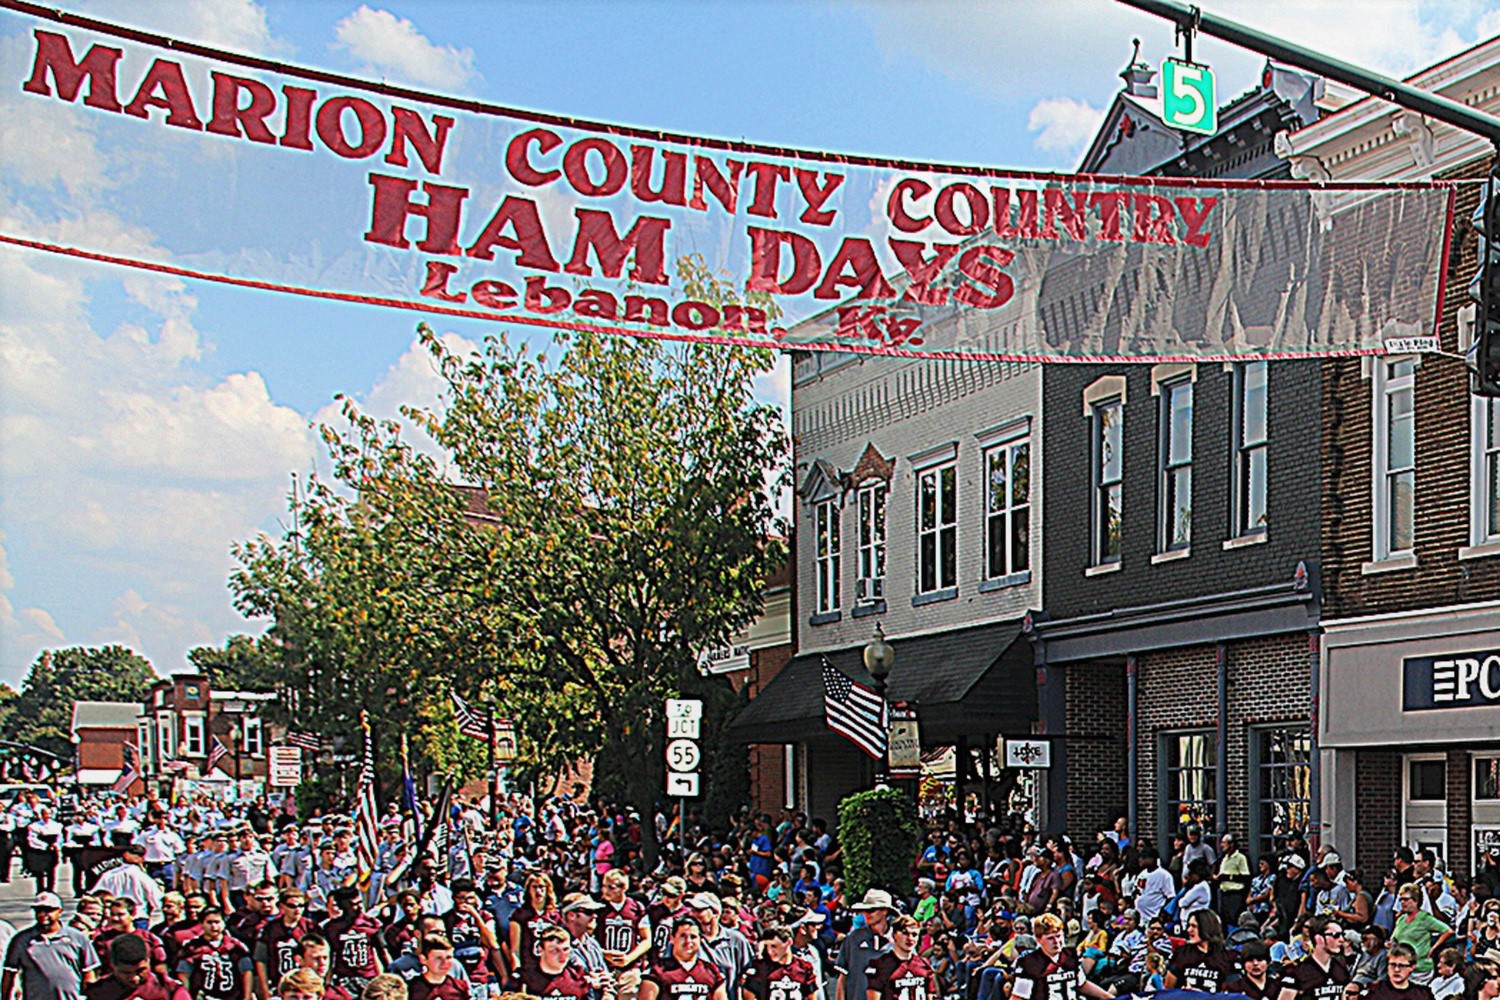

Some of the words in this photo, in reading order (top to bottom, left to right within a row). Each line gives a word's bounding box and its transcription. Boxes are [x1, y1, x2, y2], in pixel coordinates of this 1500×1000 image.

[1171, 66, 1206, 126] 5
[23, 28, 454, 175] MARION
[505, 127, 843, 225] COUNTY
[887, 177, 1219, 248] COUNTRY
[364, 172, 671, 286] HAM
[746, 227, 1015, 310] DAYS
[672, 719, 696, 734] JCT
[673, 746, 695, 765] 55
